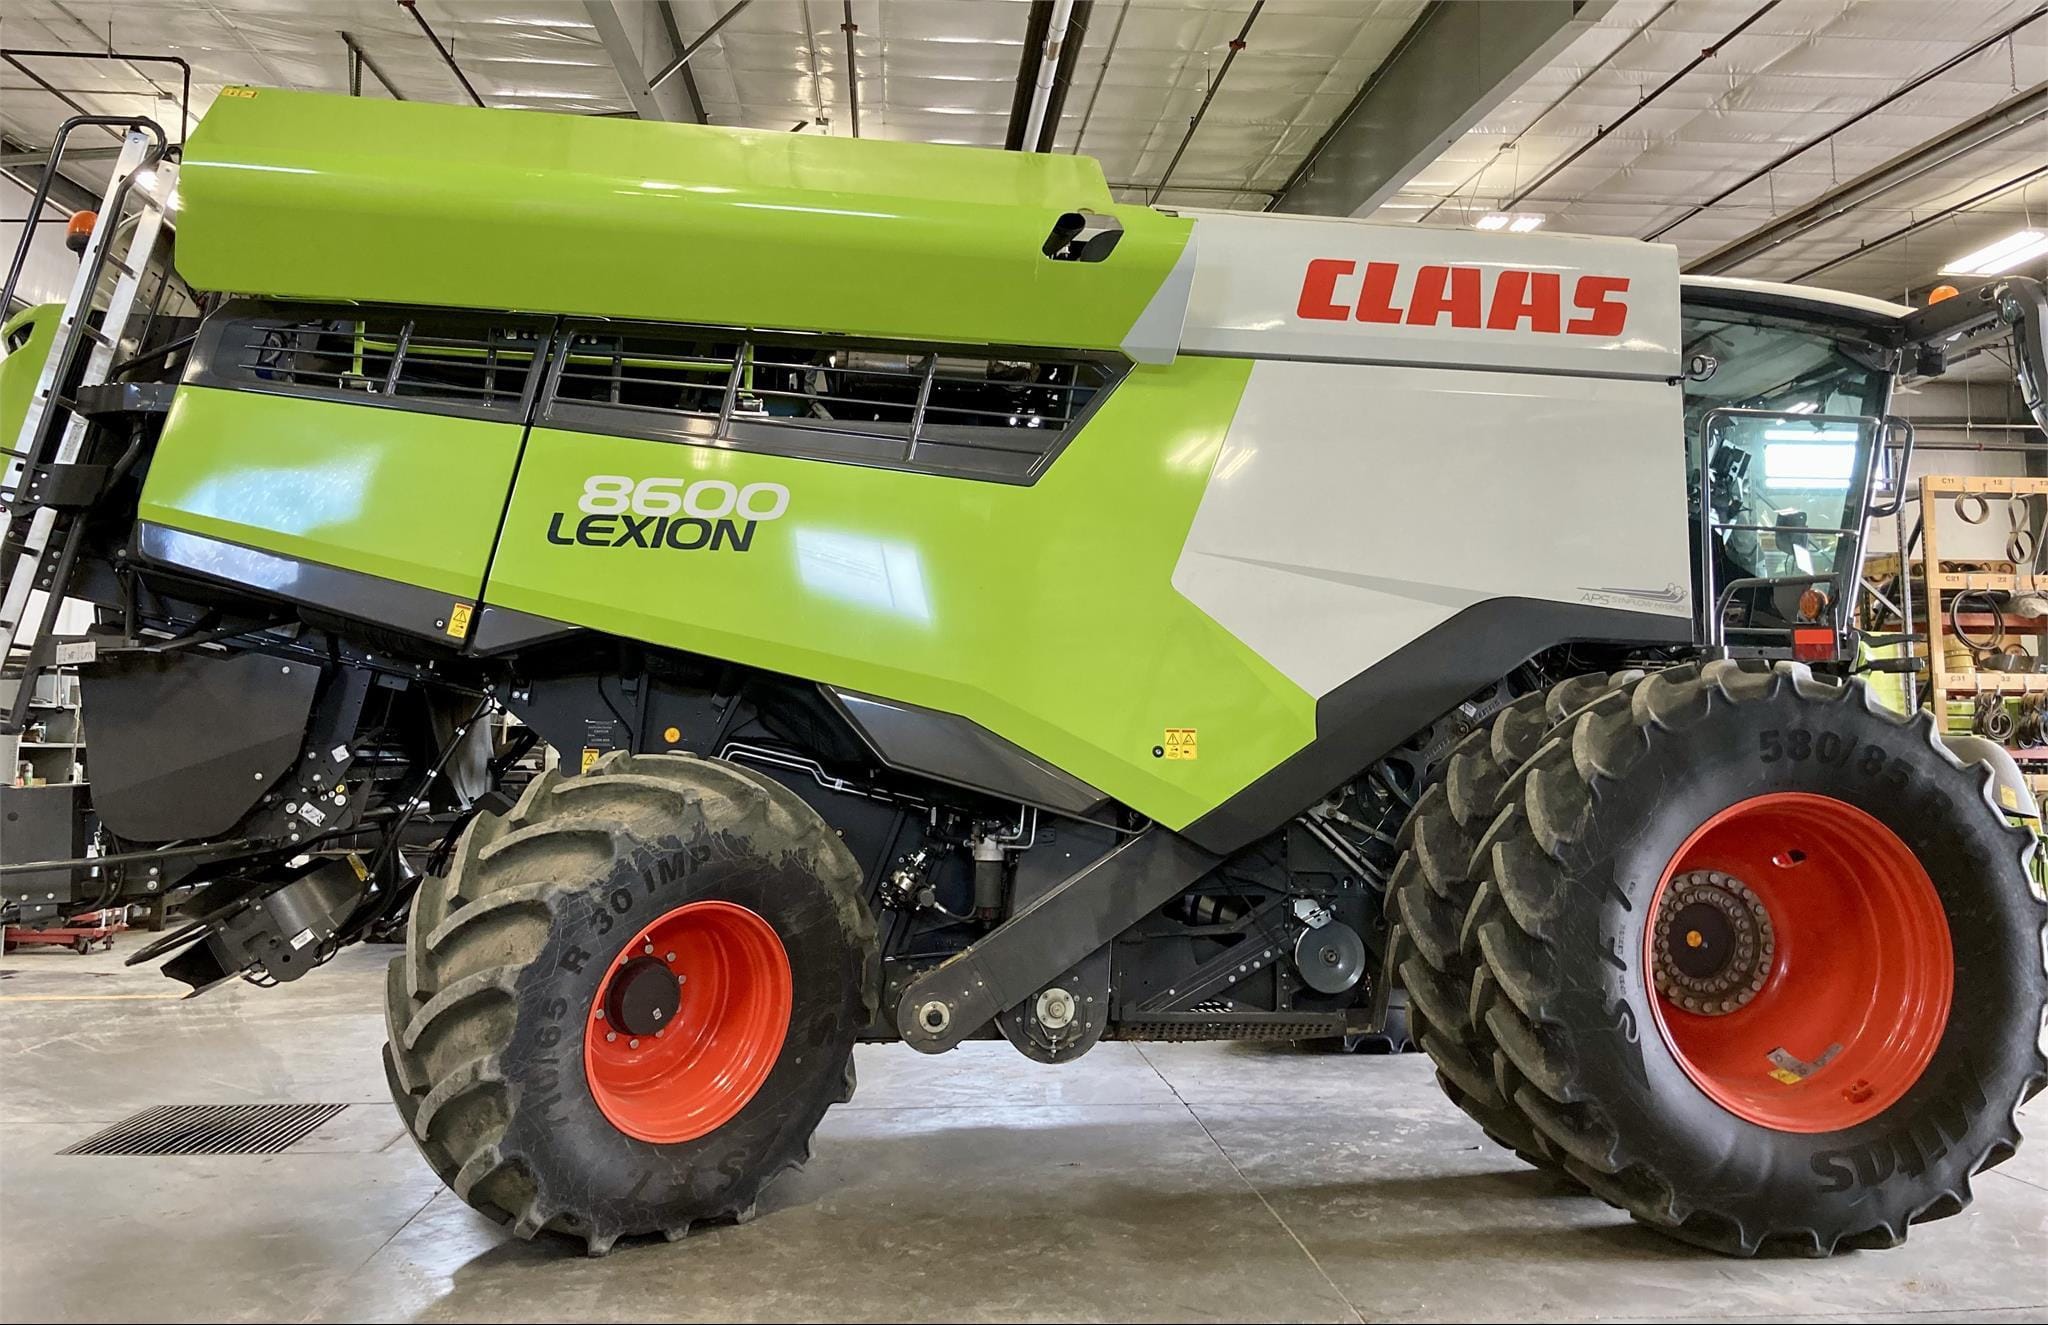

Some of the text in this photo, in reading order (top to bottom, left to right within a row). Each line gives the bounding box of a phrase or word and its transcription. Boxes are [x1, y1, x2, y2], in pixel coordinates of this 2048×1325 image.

[1297, 259, 1630, 336] CLAAS
[578, 475, 790, 520] 8600
[547, 512, 757, 552] LEXION
[1580, 592, 1610, 605] APS
[1759, 729, 1915, 787] 580/85
[559, 945, 591, 976] R
[589, 887, 633, 935] 30
